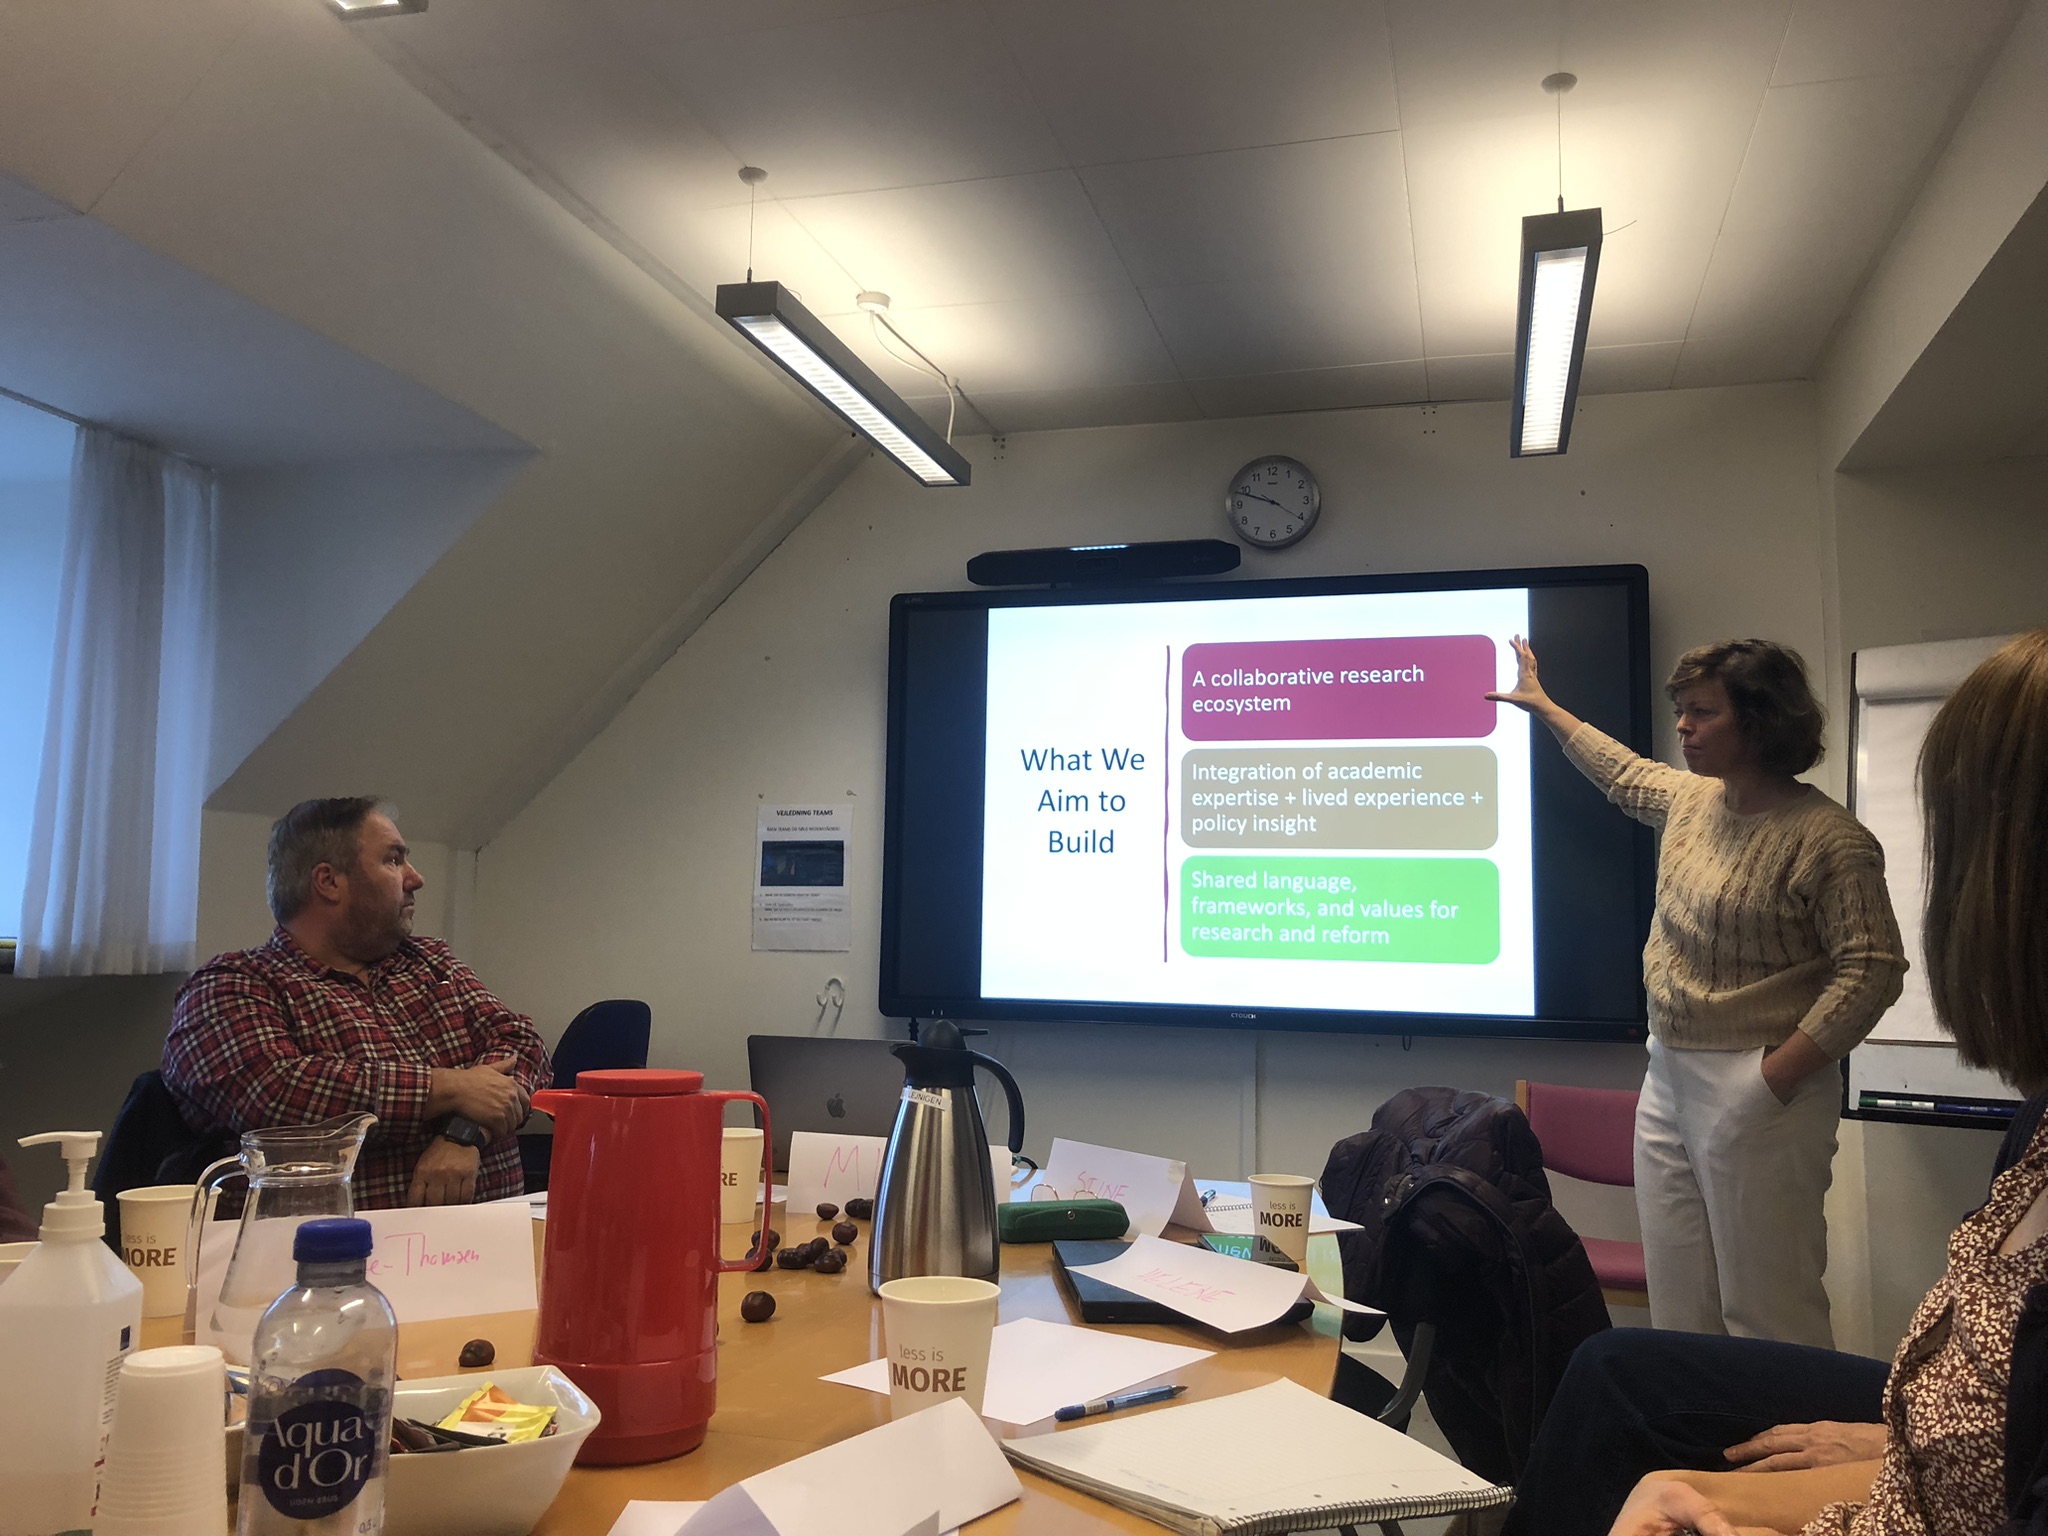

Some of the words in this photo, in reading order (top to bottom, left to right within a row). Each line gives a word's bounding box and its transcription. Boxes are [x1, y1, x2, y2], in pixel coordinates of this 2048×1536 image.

[1252, 473, 1260, 482] 11
[1267, 466, 1278, 476] 12
[1241, 485, 1251, 495] 10
[1298, 480, 1305, 489] 2
[1236, 501, 1243, 509] 9
[1303, 496, 1309, 505] 3
[1241, 516, 1248, 525] 8
[1298, 512, 1304, 520] 4
[1254, 527, 1260, 536] 7
[1270, 530, 1276, 539] 6
[1286, 525, 1293, 534] 5
[1192, 670, 1206, 687] A
[1211, 667, 1334, 687] collaborative
[1340, 664, 1425, 684] research
[1192, 696, 1291, 716] ecosystem
[1020, 747, 1093, 771] What
[1101, 747, 1145, 771] We
[1192, 763, 1297, 784] Integration
[1302, 761, 1324, 780] of
[1327, 761, 1423, 780] academic
[1037, 789, 1089, 812] Aim
[1098, 791, 1126, 812] to
[1192, 789, 1279, 810] expertise
[1302, 788, 1348, 806] lived
[1354, 788, 1465, 810] experience
[1192, 813, 1247, 836] policy
[1253, 813, 1317, 836] insight
[1049, 829, 1114, 853] Build
[1191, 870, 1257, 889] Shared
[1263, 871, 1357, 894] language,
[1191, 896, 1311, 919] frameworks,
[1317, 899, 1354, 918] and
[1360, 899, 1424, 919] values
[1429, 899, 1459, 919] for
[1191, 923, 1274, 942] research
[1279, 925, 1316, 943] and
[1322, 925, 1390, 944] reform
[1269, 1200, 1286, 1210] less
[1289, 1201, 1296, 1210] is
[1260, 1211, 1303, 1228] MORE
[146, 1231, 157, 1244] is
[899, 1343, 926, 1361] less
[932, 1346, 944, 1361] is
[892, 1362, 967, 1393] MORE
